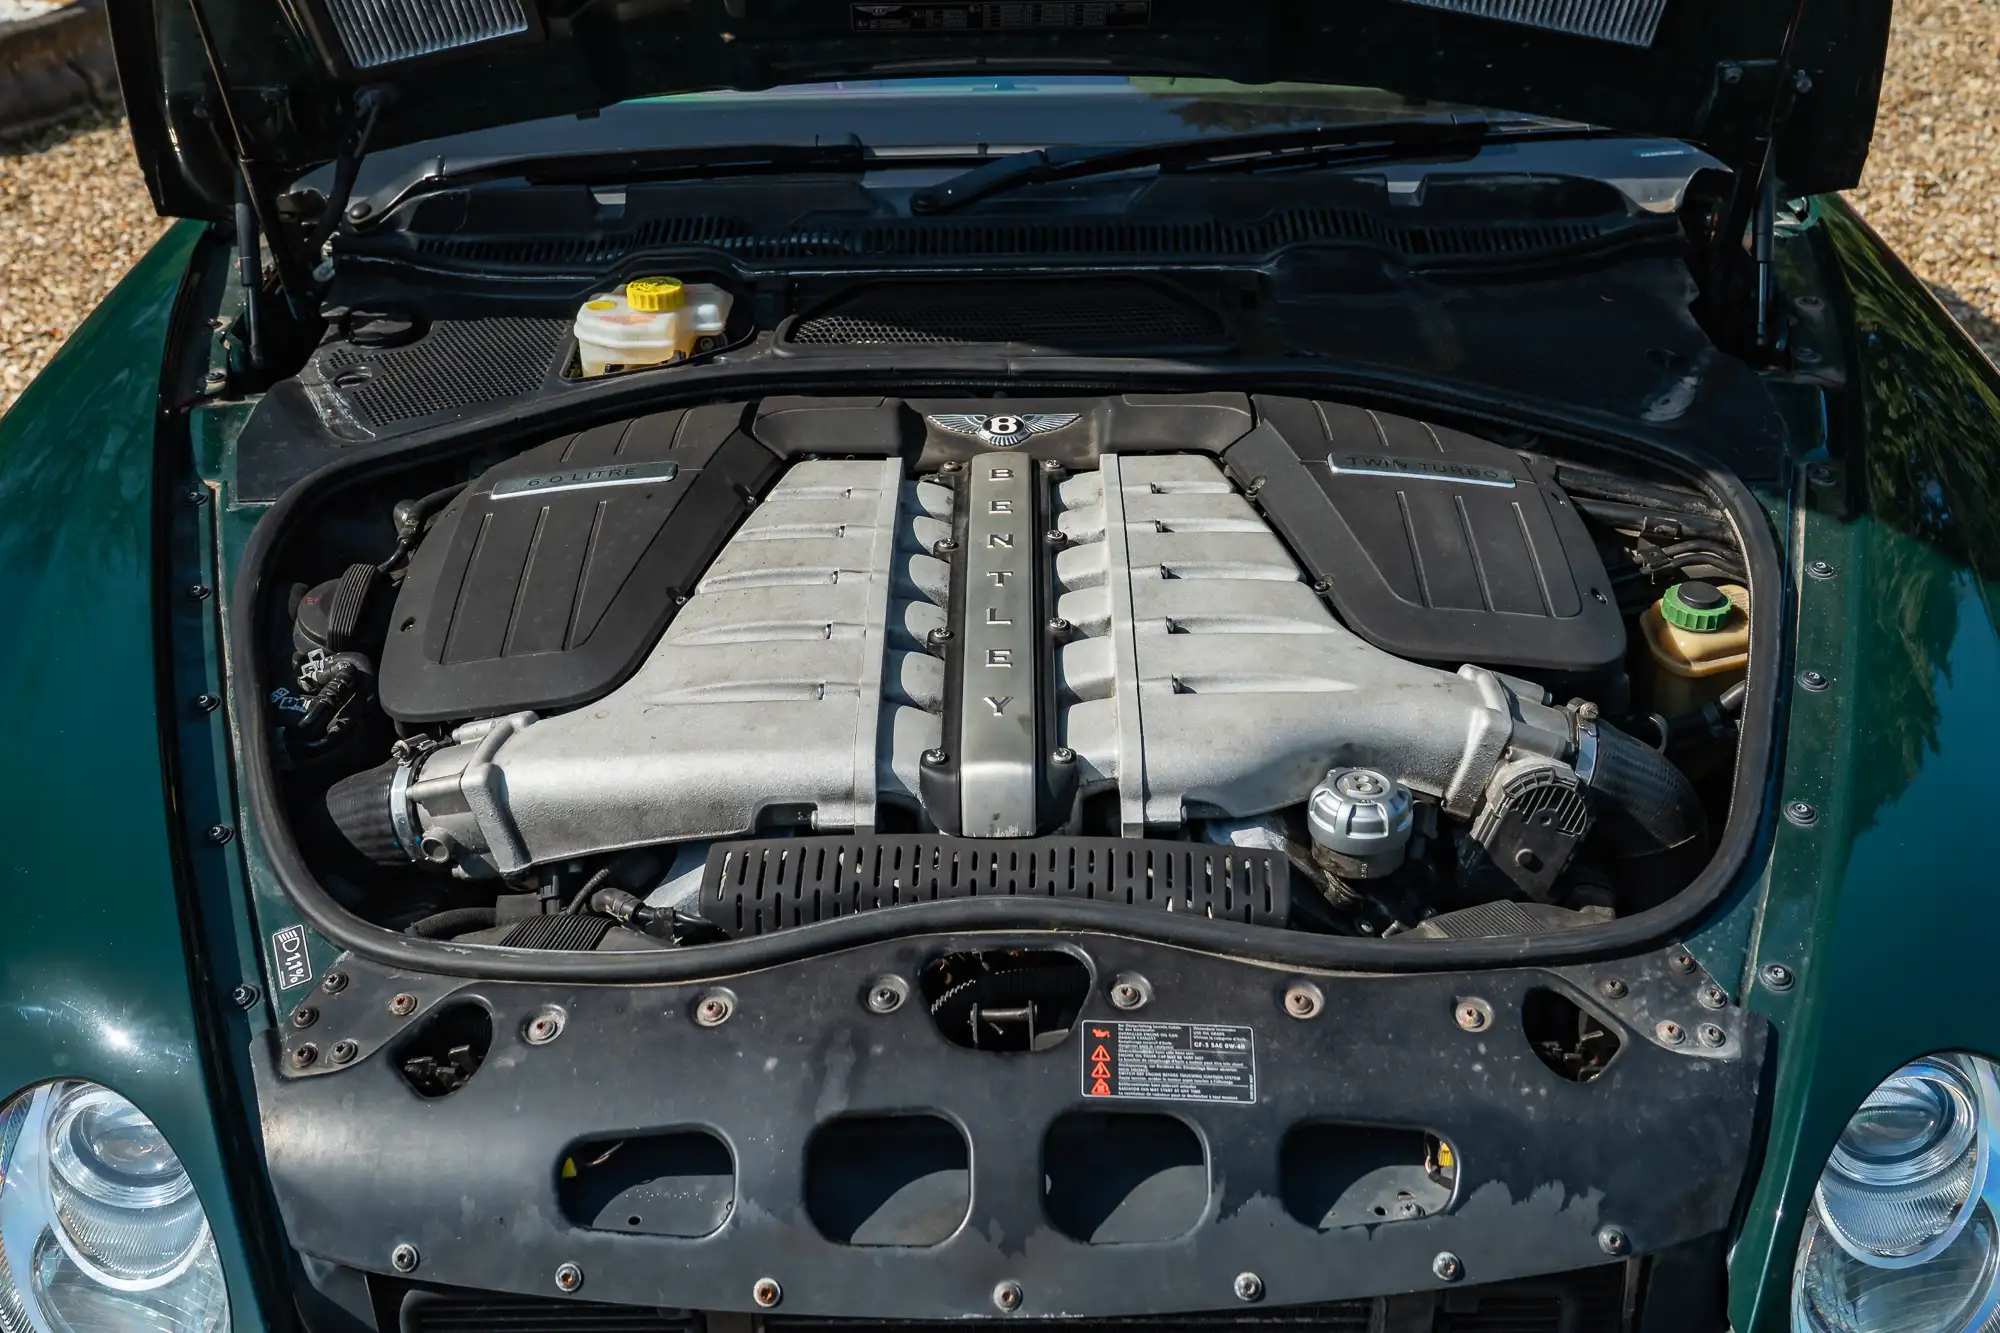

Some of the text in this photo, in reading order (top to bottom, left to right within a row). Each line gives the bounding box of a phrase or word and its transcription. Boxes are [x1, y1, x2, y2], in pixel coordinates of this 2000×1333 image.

[989, 417, 1018, 434] B
[528, 467, 638, 487] 6.0 LITRE
[1346, 456, 1499, 479] TWIN TURBO
[983, 468, 1015, 717] BENTLEY
[285, 952, 305, 984] 1,1%
